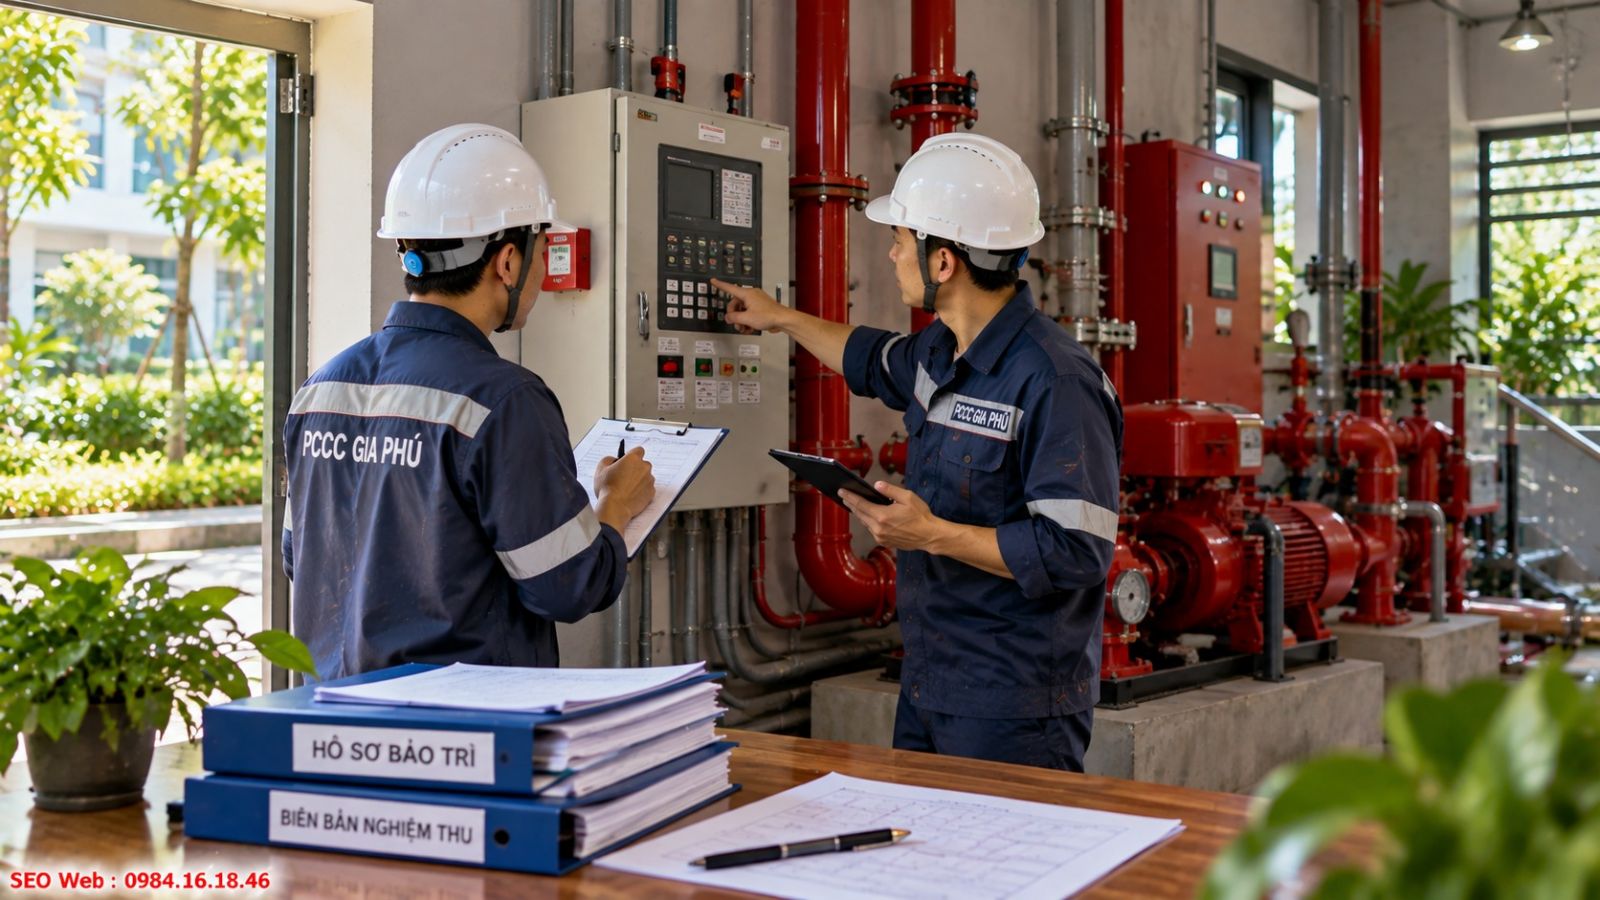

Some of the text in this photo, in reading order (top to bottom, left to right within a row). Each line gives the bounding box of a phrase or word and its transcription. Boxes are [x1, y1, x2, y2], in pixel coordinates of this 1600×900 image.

[953, 403, 975, 422] PCCC
[972, 409, 987, 426] GIA
[302, 430, 423, 468] PCCC GIA PHÚ
[351, 742, 382, 761] SƠ
[388, 738, 435, 765] BẢO
[441, 743, 476, 767] TRÌ
[280, 806, 473, 844] BIÊN BẢN NGHIỆM THU
